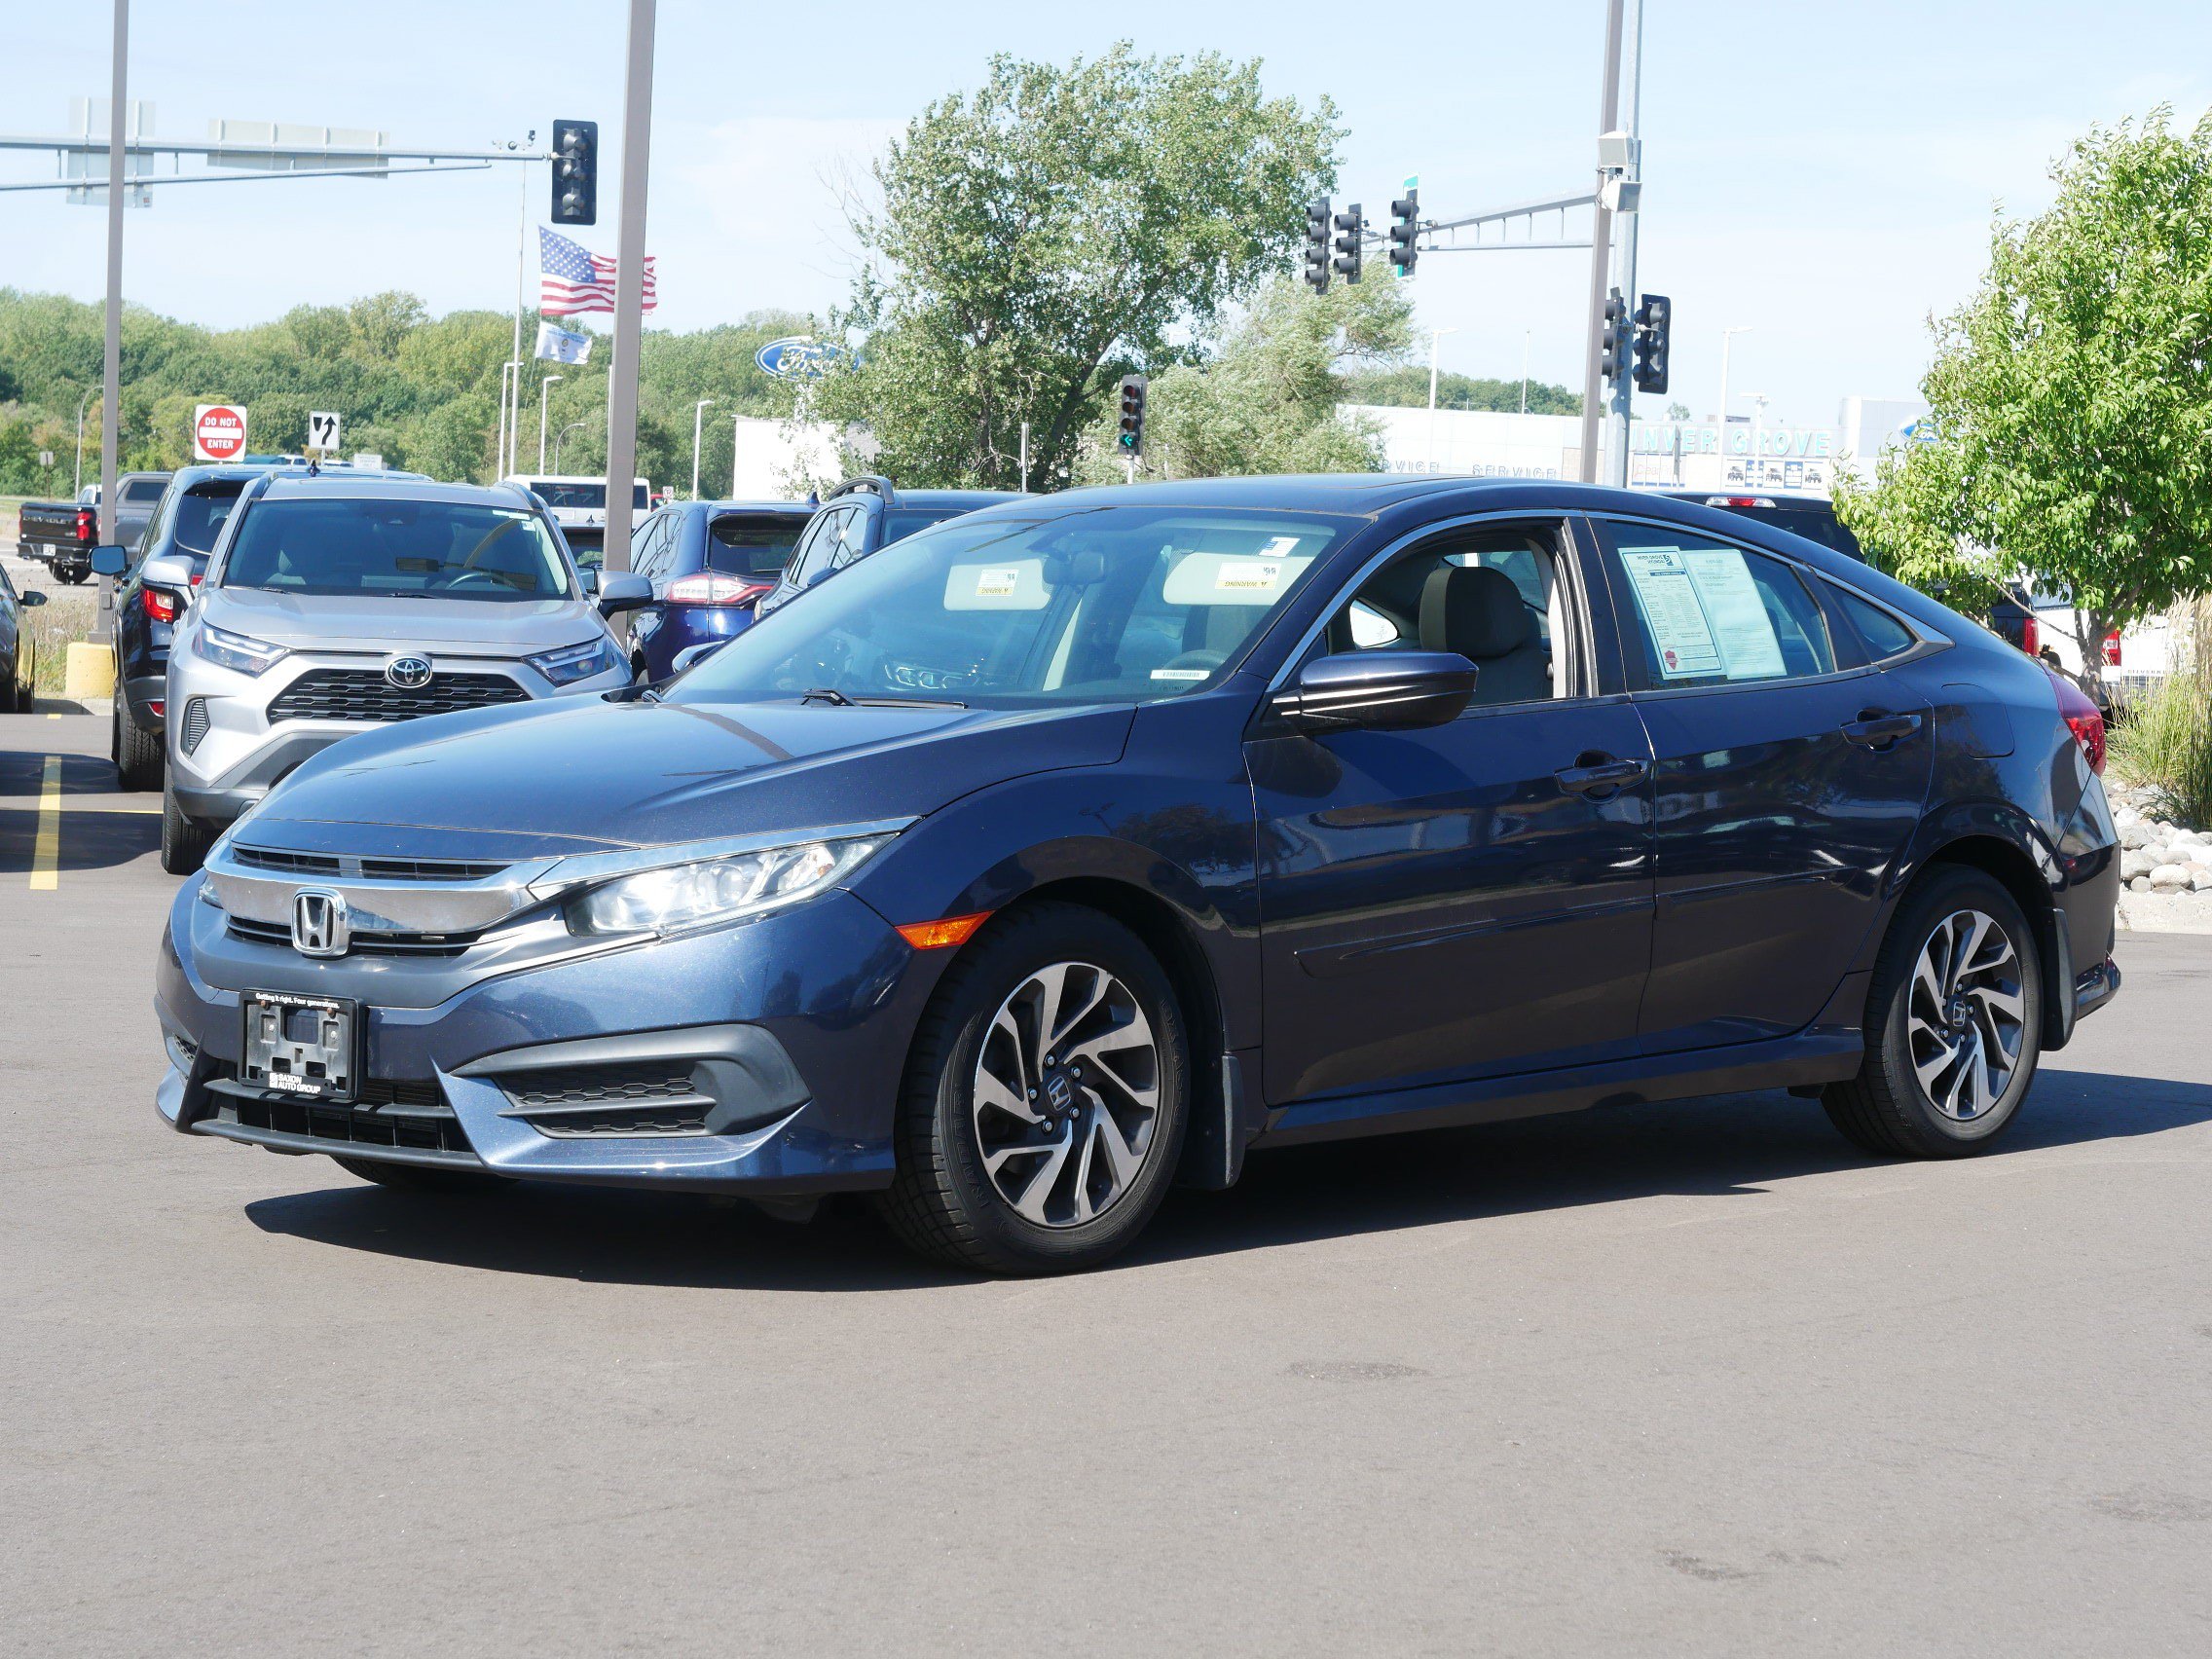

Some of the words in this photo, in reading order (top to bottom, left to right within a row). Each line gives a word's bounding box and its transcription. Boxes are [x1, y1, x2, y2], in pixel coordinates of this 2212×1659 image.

[204, 417, 216, 426] DO
[220, 418, 237, 427] NOT
[207, 439, 234, 449] ENTER
[1630, 426, 1715, 453] INVER
[1731, 428, 1829, 456] GROVE
[1381, 460, 1439, 473] RVICE
[1471, 464, 1557, 478] SERVICE
[278, 1074, 302, 1084] SAXON
[278, 1082, 296, 1090] AUTO
[297, 1084, 320, 1093] GROUP
